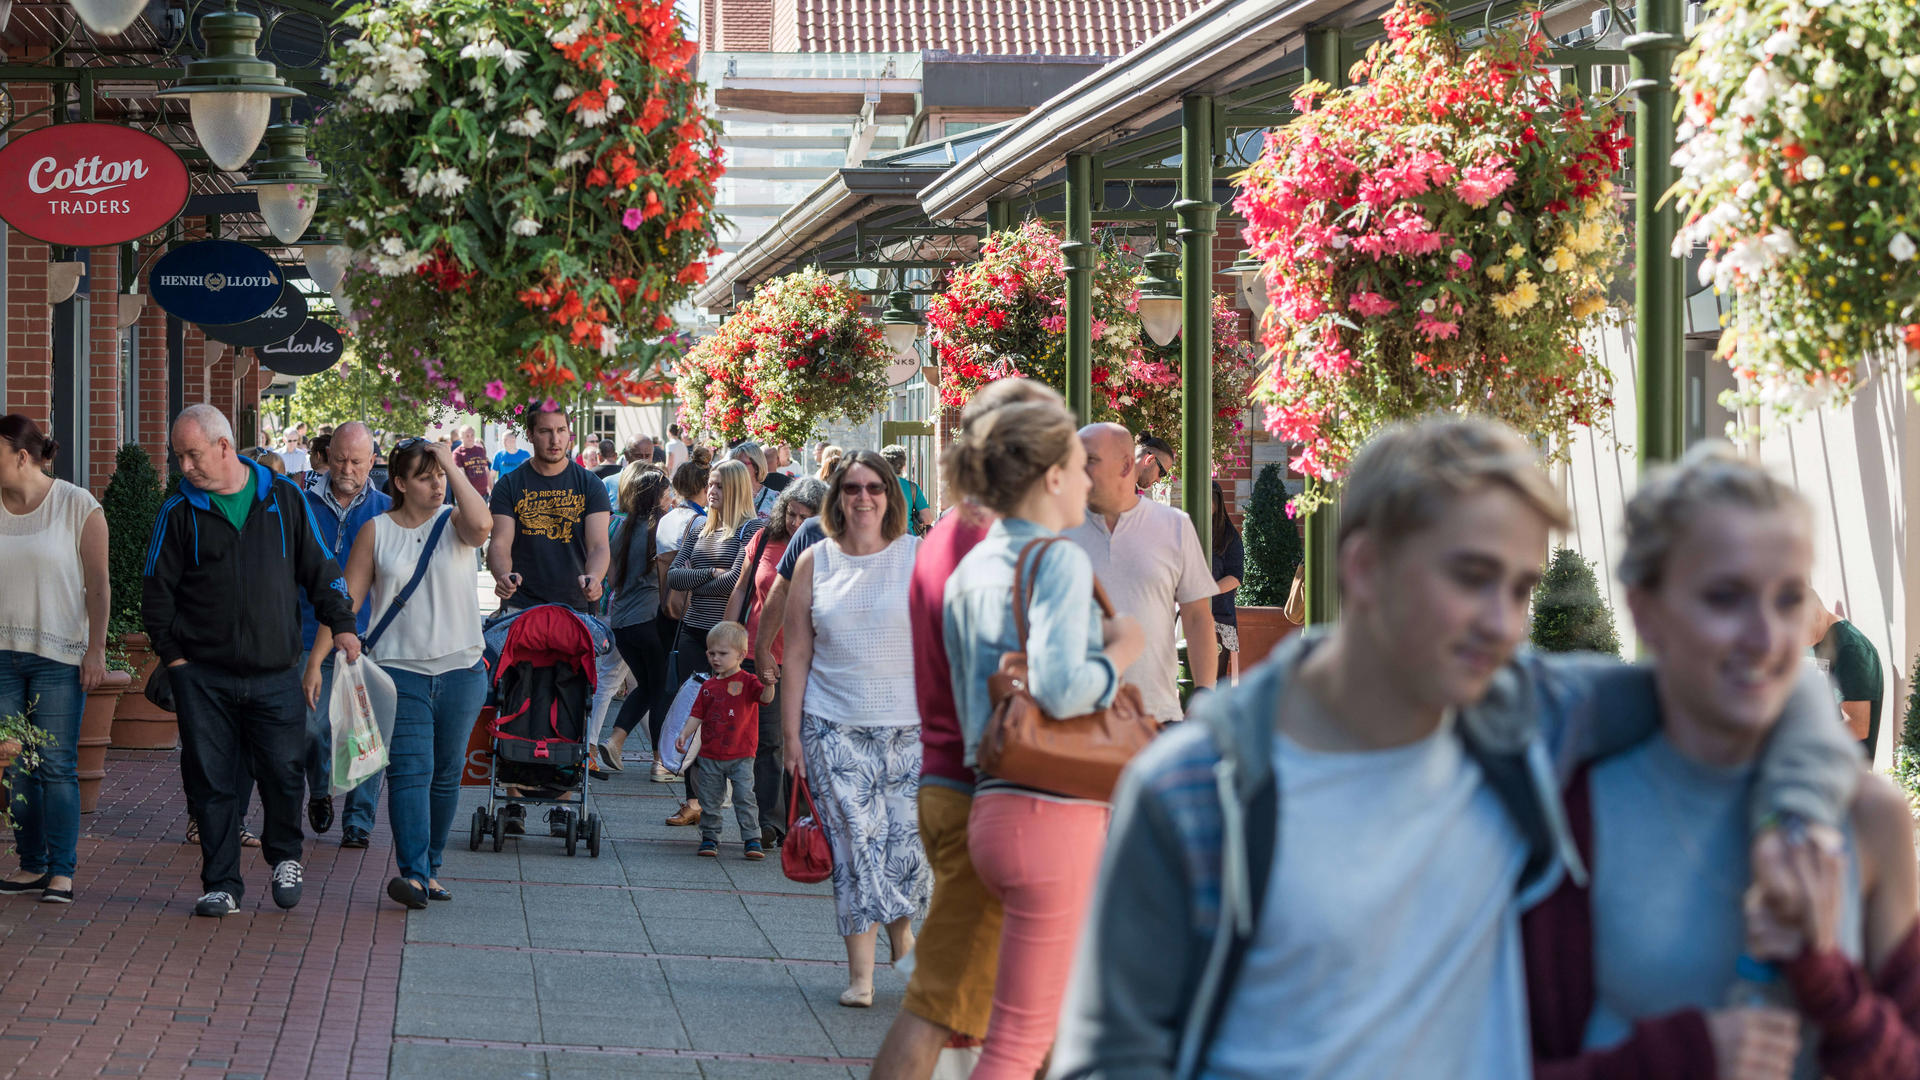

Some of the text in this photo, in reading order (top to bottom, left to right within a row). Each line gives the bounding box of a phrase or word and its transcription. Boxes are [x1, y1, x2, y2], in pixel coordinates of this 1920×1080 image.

[28, 155, 149, 194] Cotton
[48, 200, 130, 215] TRADERS
[160, 275, 271, 287] HENRI LLOYD
[263, 335, 334, 353] Clarks
[539, 489, 567, 498] RIDERS
[514, 488, 586, 519] Superdry
